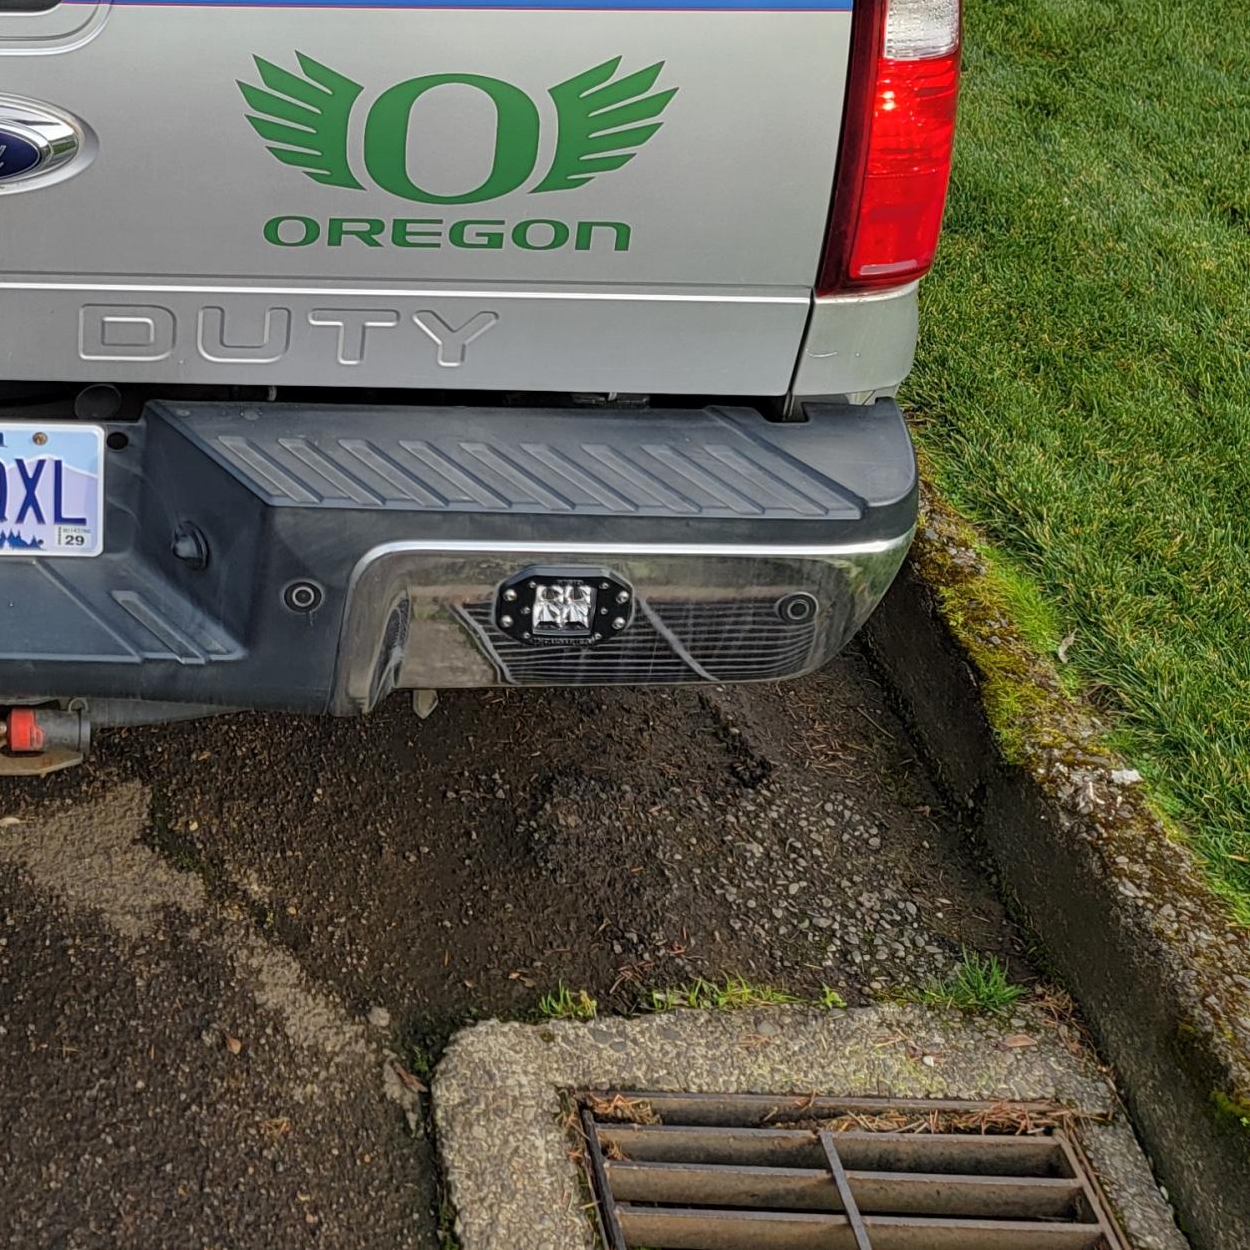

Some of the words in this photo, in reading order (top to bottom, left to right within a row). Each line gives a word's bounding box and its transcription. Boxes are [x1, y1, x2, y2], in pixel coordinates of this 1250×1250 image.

[263, 215, 632, 252] OREGON
[79, 304, 499, 367] DUTY
[64, 534, 85, 546] 29
